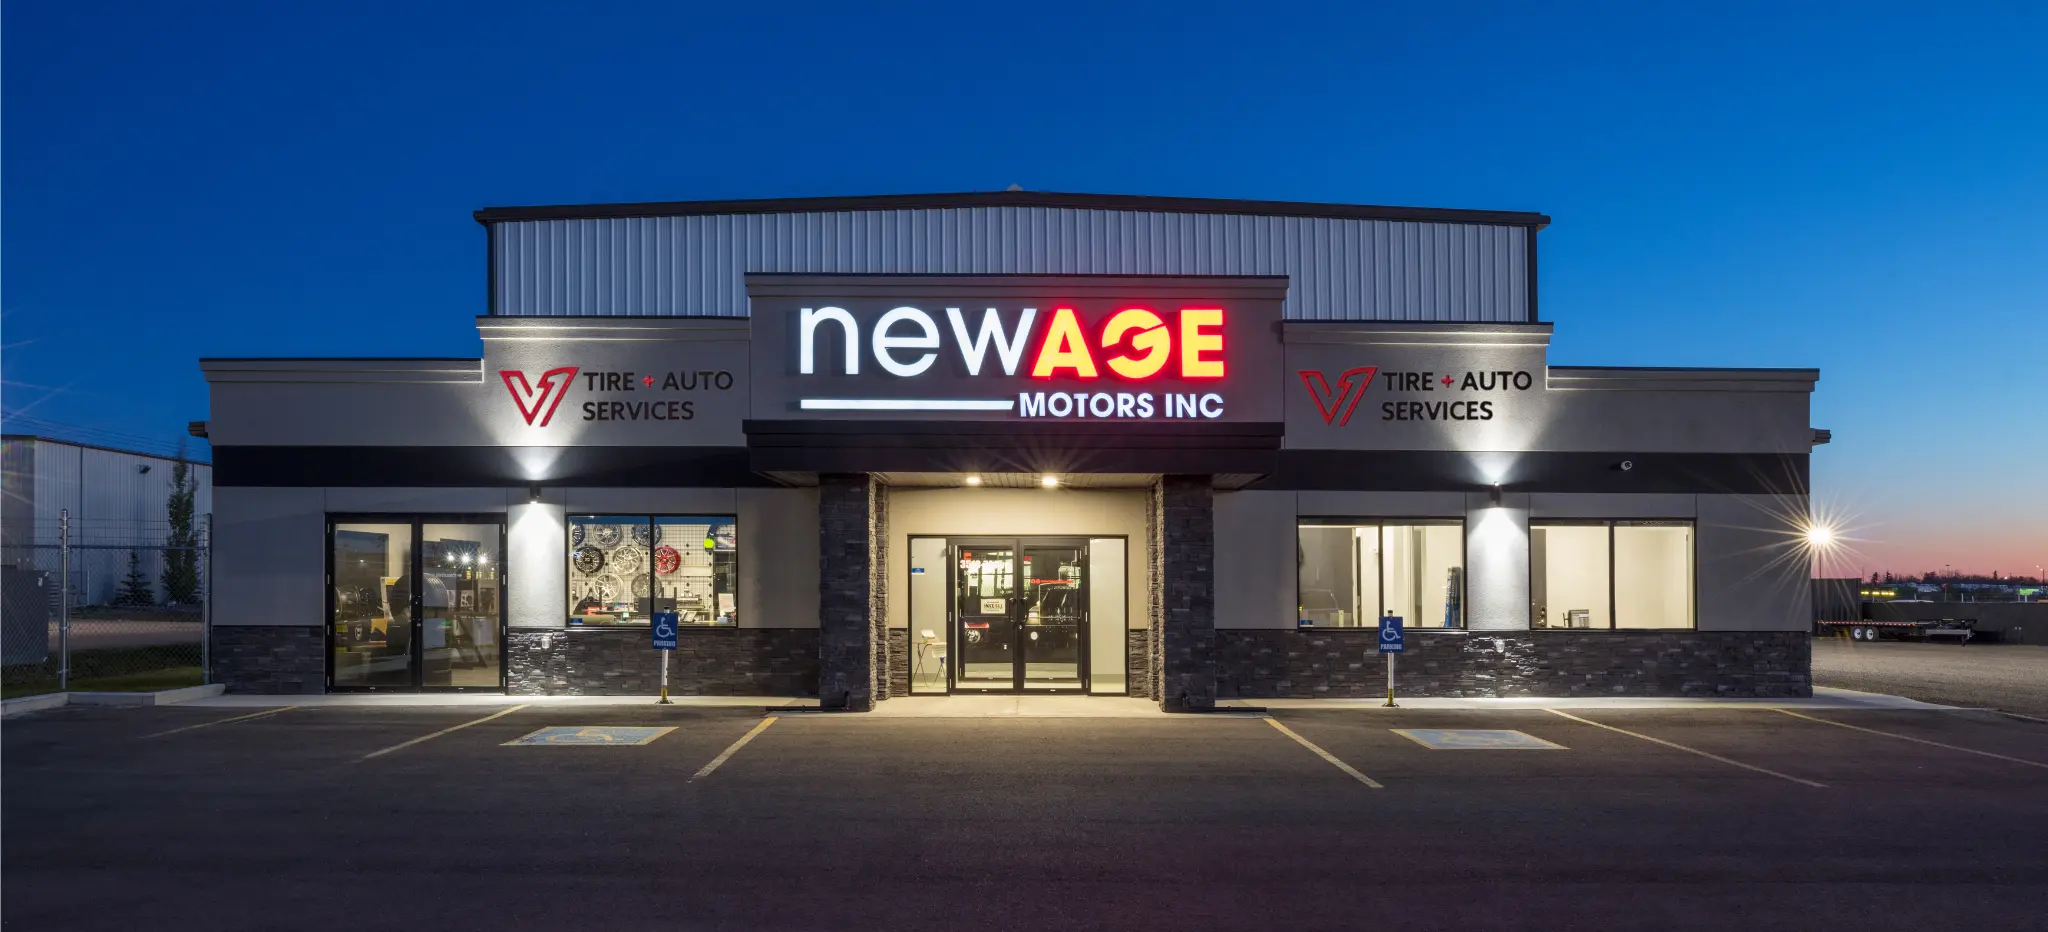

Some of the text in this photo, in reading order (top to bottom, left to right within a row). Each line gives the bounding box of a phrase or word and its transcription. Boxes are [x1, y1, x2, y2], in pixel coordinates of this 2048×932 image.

[582, 371, 734, 392] TIRE + AUTO
[1381, 370, 1533, 392] TIRE + AUTO
[581, 400, 695, 422] SERVICES
[1019, 392, 1225, 419] MOTORS INC
[1381, 400, 1494, 421] SERVICES
[653, 639, 676, 648] PARKING
